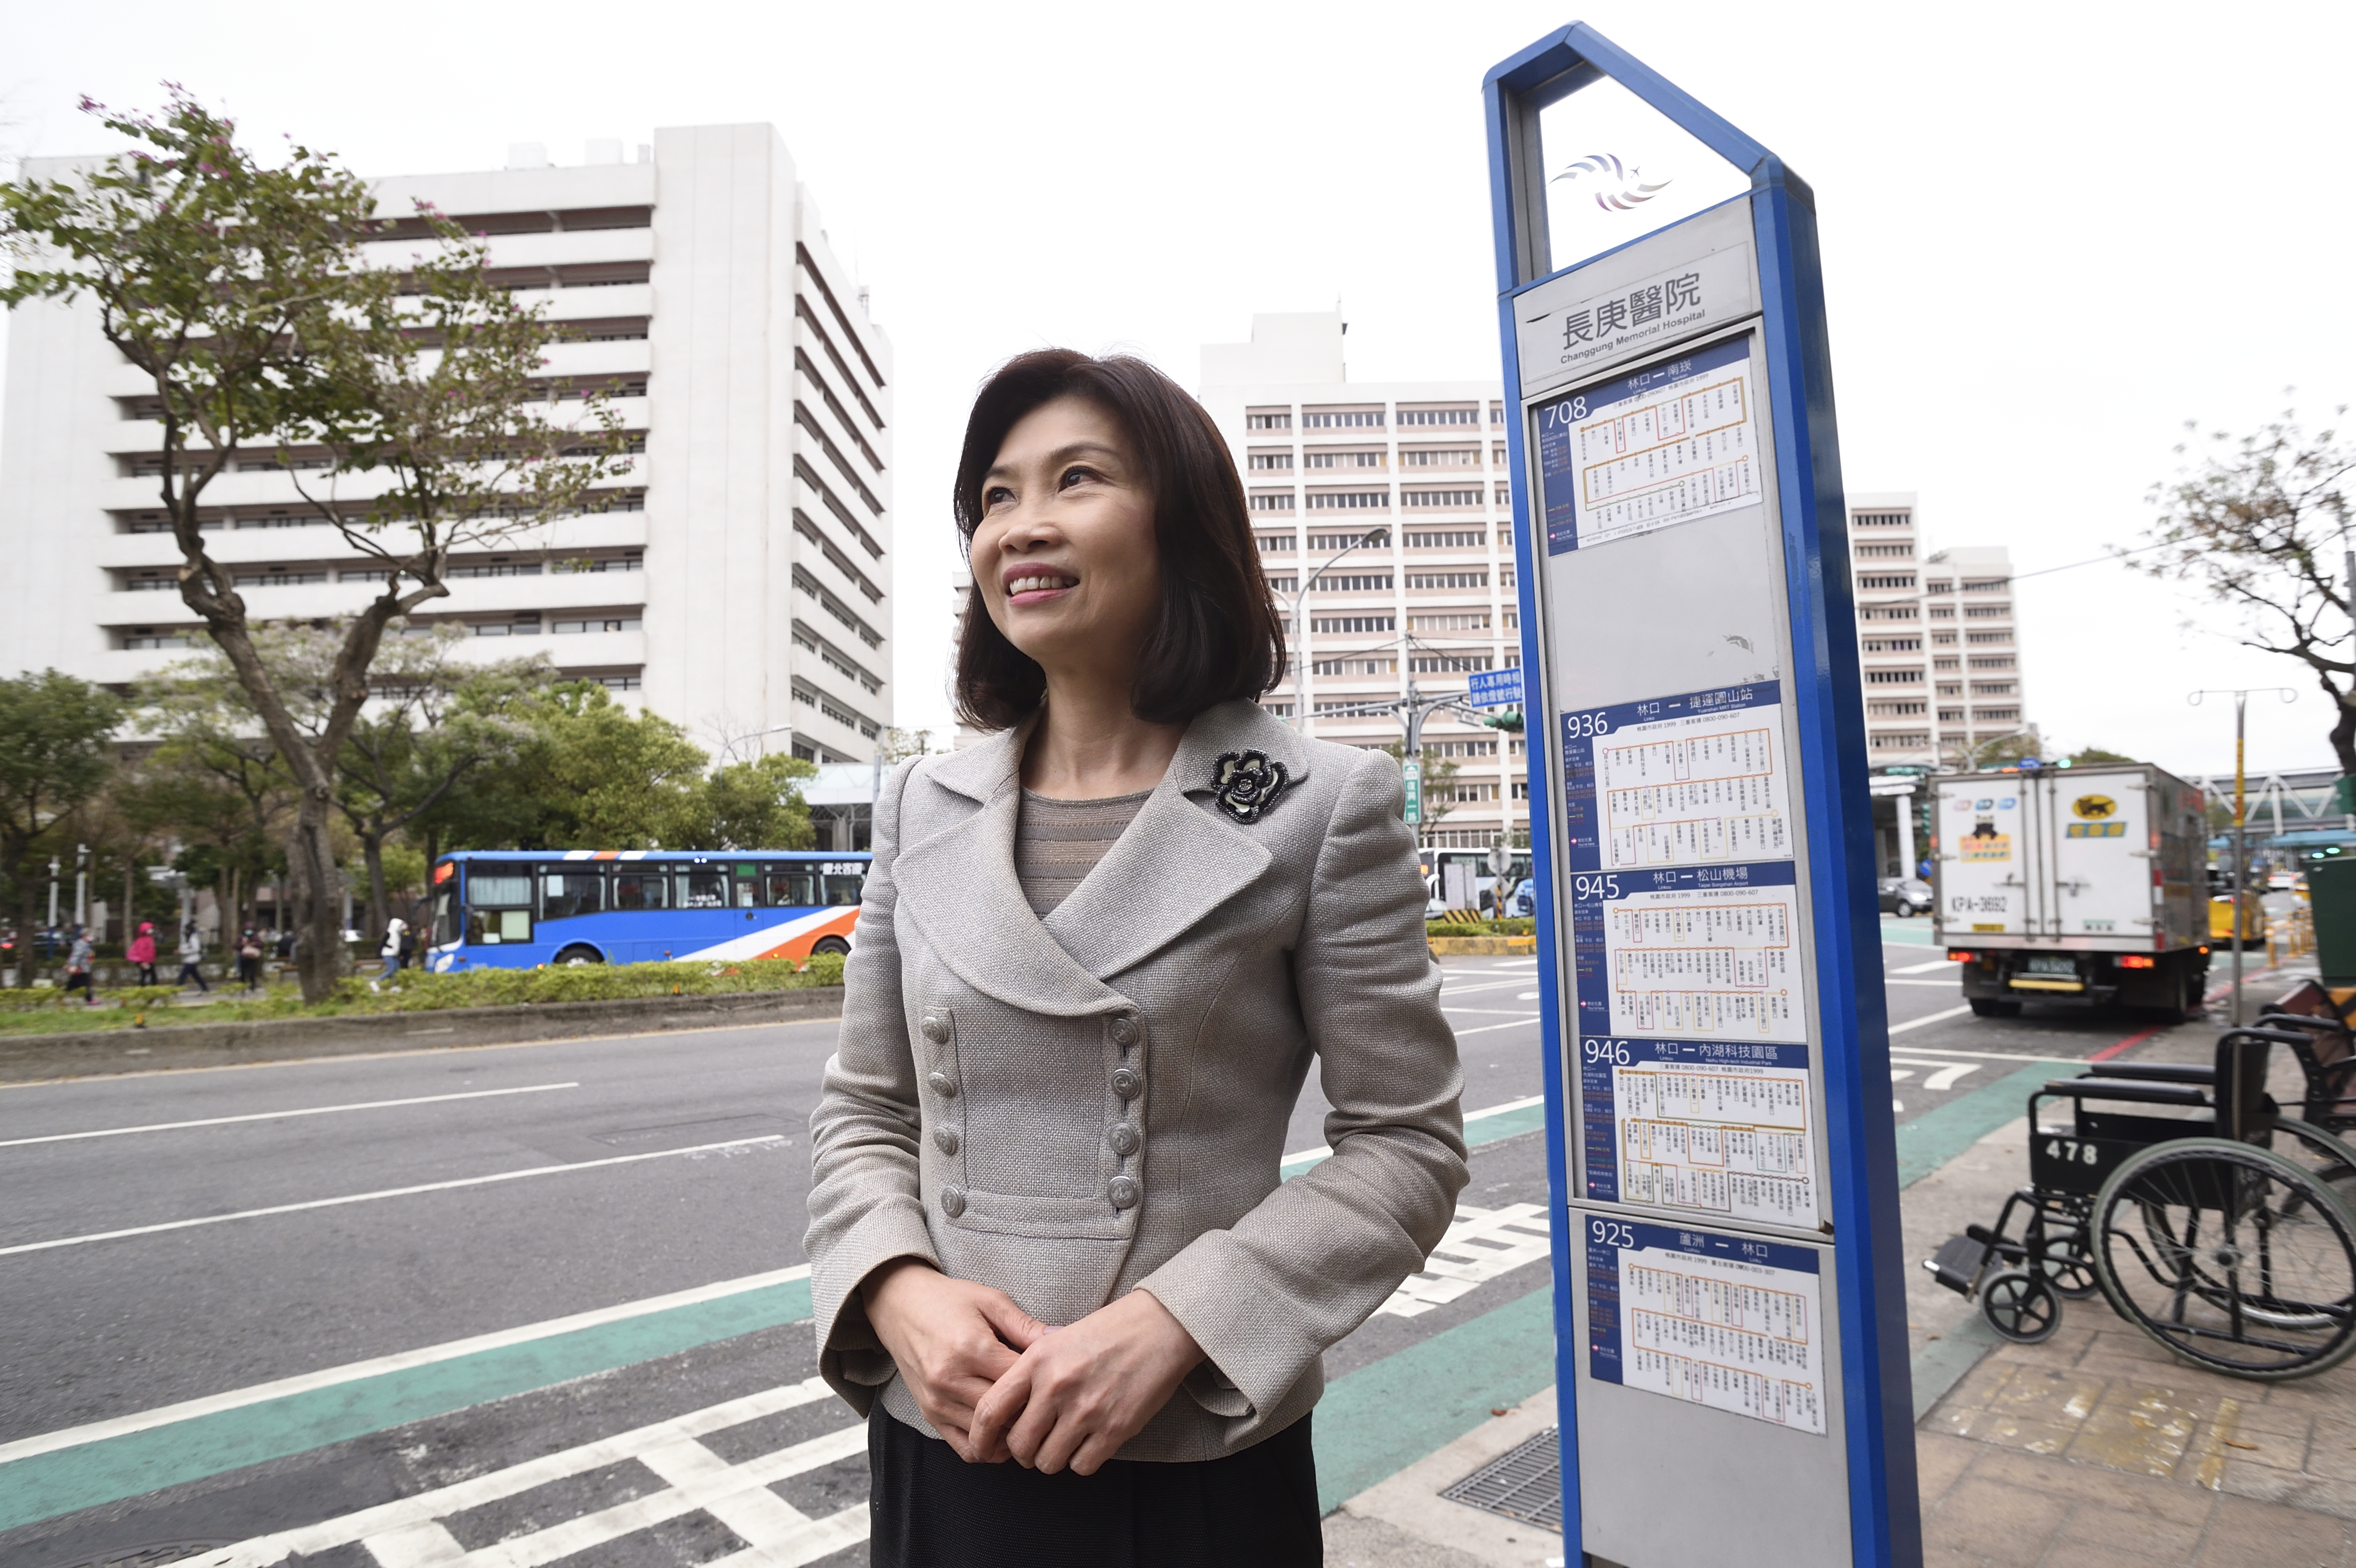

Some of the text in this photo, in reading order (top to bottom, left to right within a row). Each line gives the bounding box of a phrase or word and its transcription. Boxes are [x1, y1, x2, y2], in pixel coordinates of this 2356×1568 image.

[1563, 273, 1701, 350] 長庚醫院
[1560, 309, 1705, 364] Changgung Memorial Hospital
[1627, 359, 1691, 390] 林口 南崁
[1696, 373, 1709, 381] 1999
[1545, 396, 1587, 428] 708
[1637, 687, 1753, 716] 林口 捷運圓山站
[1568, 712, 1607, 739] 936
[1680, 717, 1702, 725] 三重客運
[1702, 712, 1740, 722] 0800-090-607
[1576, 874, 1619, 900] 945
[1653, 867, 1747, 883] 林口 松山機場
[1585, 1039, 1630, 1065] 946
[1655, 1042, 1778, 1059] 林口 內湖科技園區
[2046, 1140, 2098, 1165] 478
[1592, 1220, 1634, 1248] 925
[1680, 1232, 1767, 1257] 蘆洲 林口
